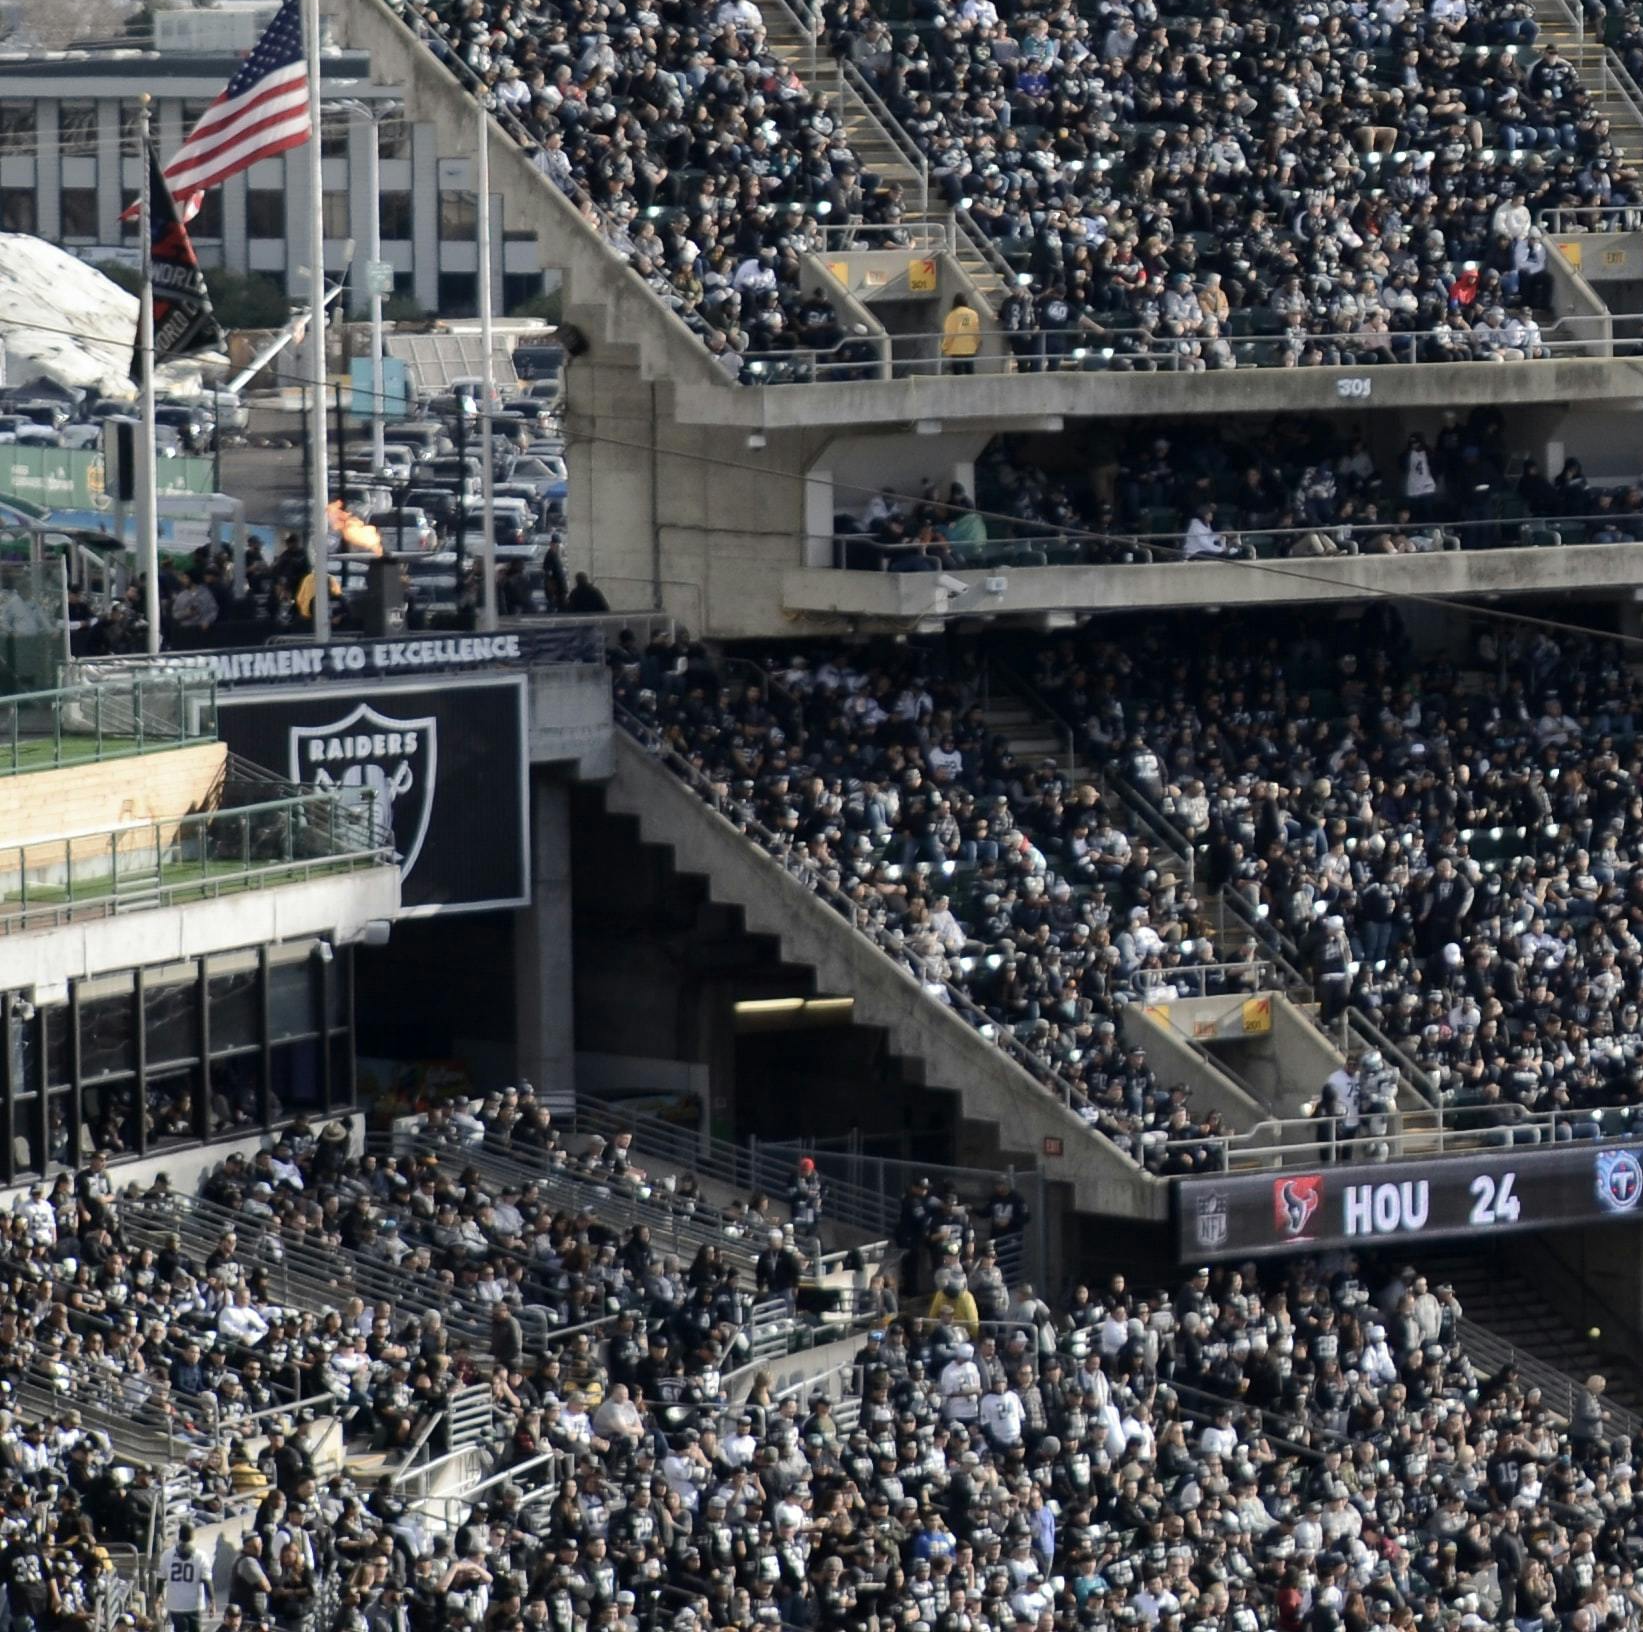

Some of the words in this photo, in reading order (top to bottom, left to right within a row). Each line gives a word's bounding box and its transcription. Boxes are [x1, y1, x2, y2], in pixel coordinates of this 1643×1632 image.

[330, 646, 365, 671] TO
[374, 635, 521, 667] EXCELLENCE
[309, 731, 418, 762] RAIDERS
[1345, 1180, 1429, 1235] HOU
[1470, 1172, 1521, 1225] 24
[171, 1561, 194, 1583] 20
